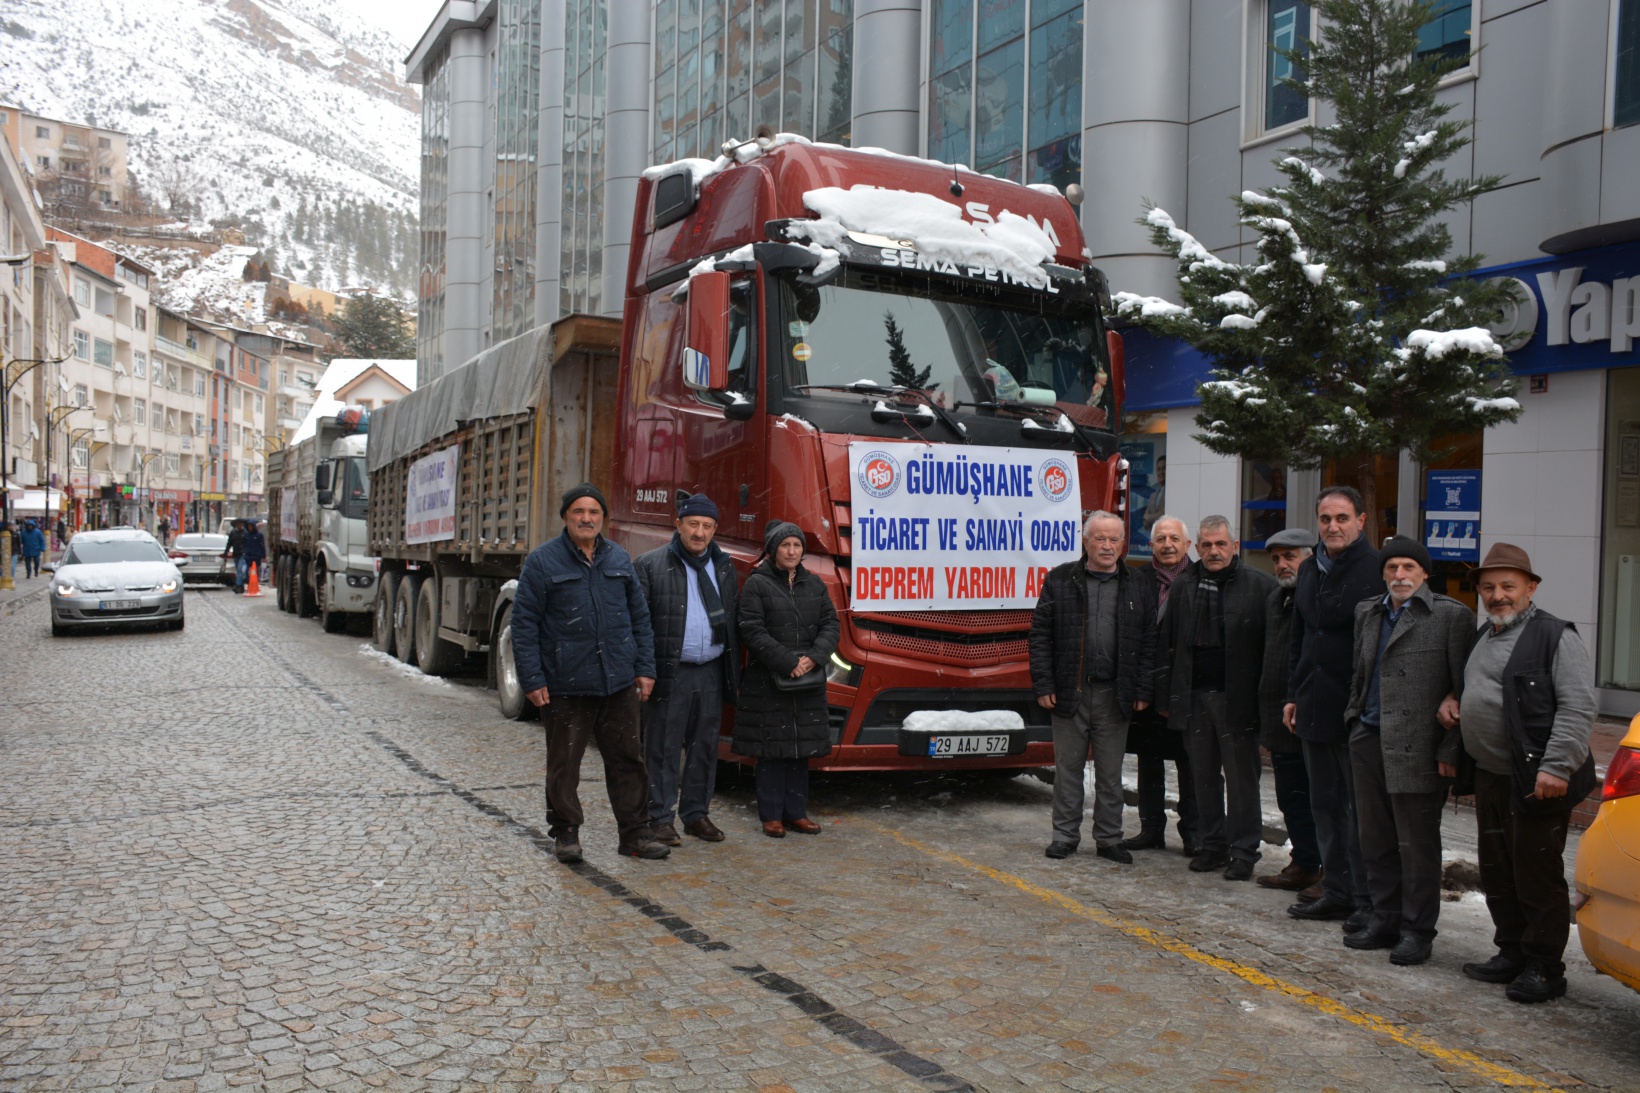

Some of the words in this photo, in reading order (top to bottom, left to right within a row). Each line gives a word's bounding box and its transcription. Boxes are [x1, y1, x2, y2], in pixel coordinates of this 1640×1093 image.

[880, 249, 960, 276] SEMA
[906, 453, 1033, 505] GÜMÜŞHANE
[636, 489, 643, 502] 29
[643, 489, 656, 503] AAJ
[656, 490, 668, 504] 572
[858, 508, 930, 551] TİCARET
[938, 518, 958, 551] VE
[965, 512, 1024, 551] SANAYİ
[1031, 519, 1076, 552] ODASI
[856, 566, 935, 600] DEPREM
[944, 566, 1016, 599] YARDIM
[1024, 566, 1055, 598] AR
[936, 738, 951, 753] 29
[957, 737, 980, 753] AAJ
[986, 737, 1008, 752] 572
